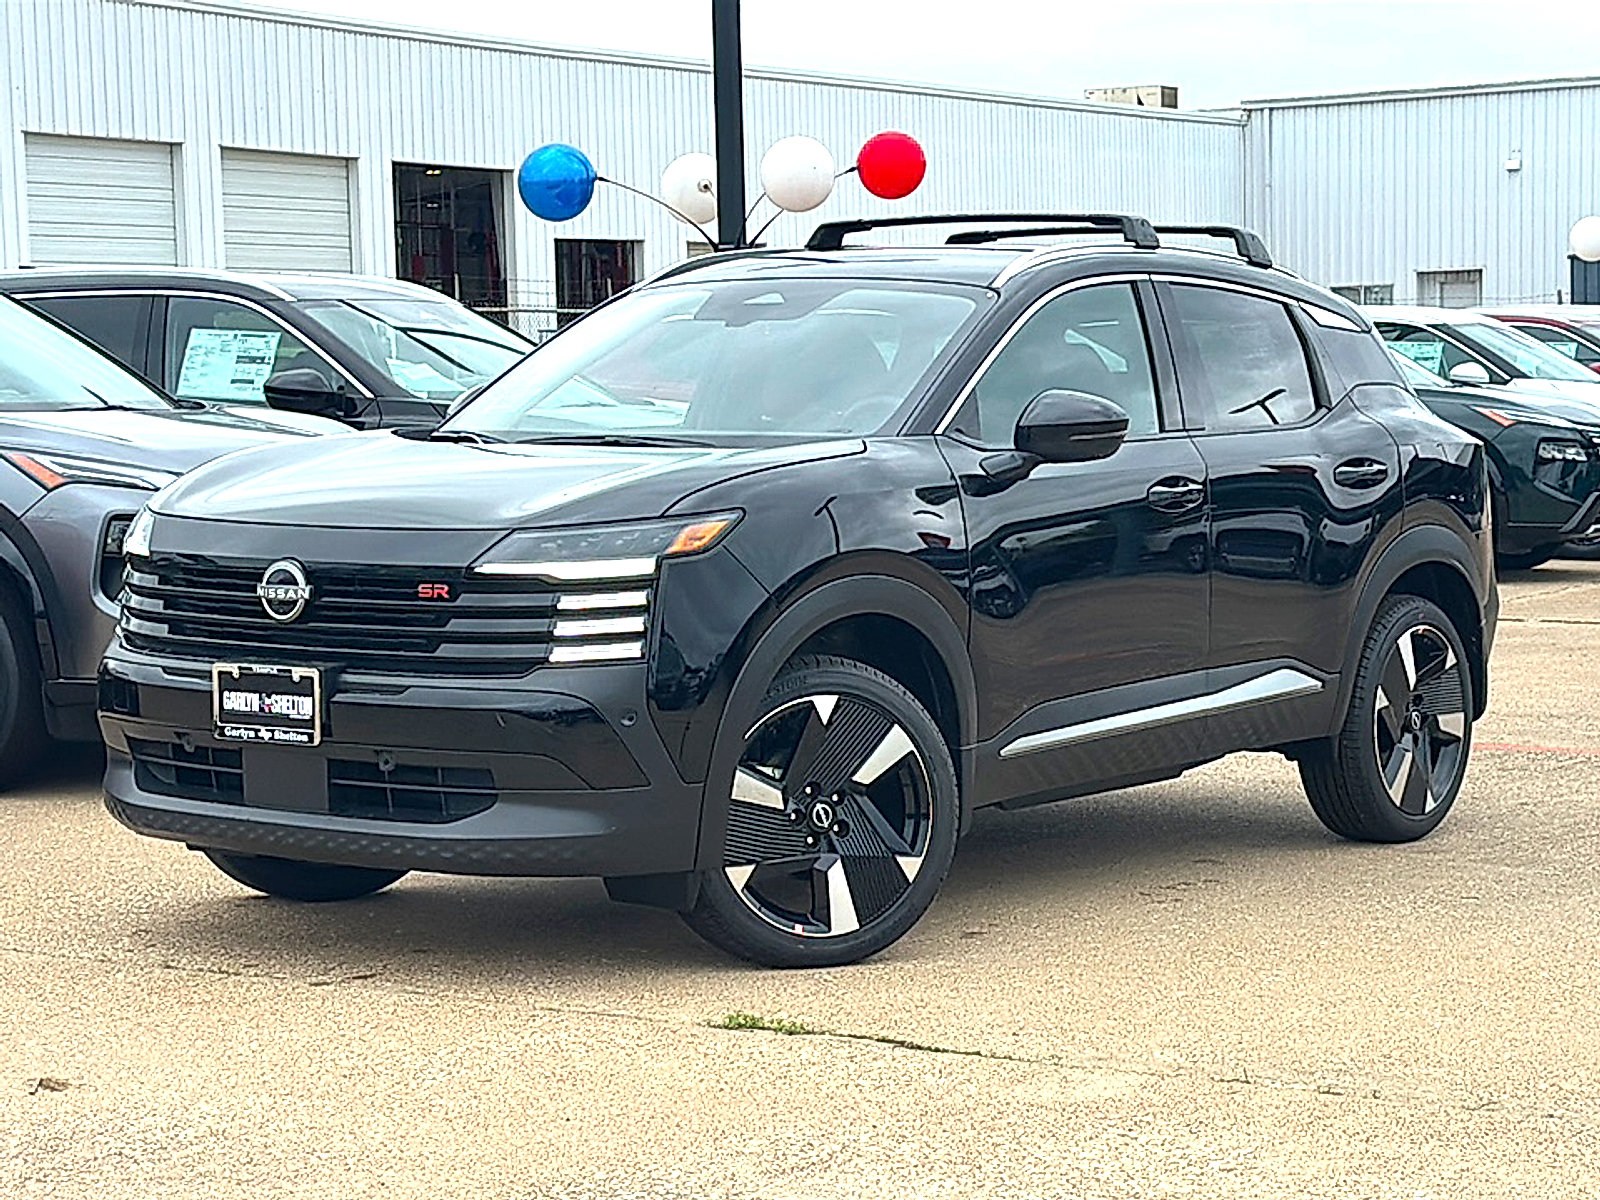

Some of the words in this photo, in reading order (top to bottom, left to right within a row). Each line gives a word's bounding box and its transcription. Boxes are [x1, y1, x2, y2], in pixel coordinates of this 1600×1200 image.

[257, 584, 310, 599] NISSAN
[418, 584, 449, 598] SR
[223, 691, 260, 711] GARLYN
[271, 694, 313, 716] SHELTON
[224, 727, 255, 740] Garlyn
[274, 730, 309, 742] Shelton
